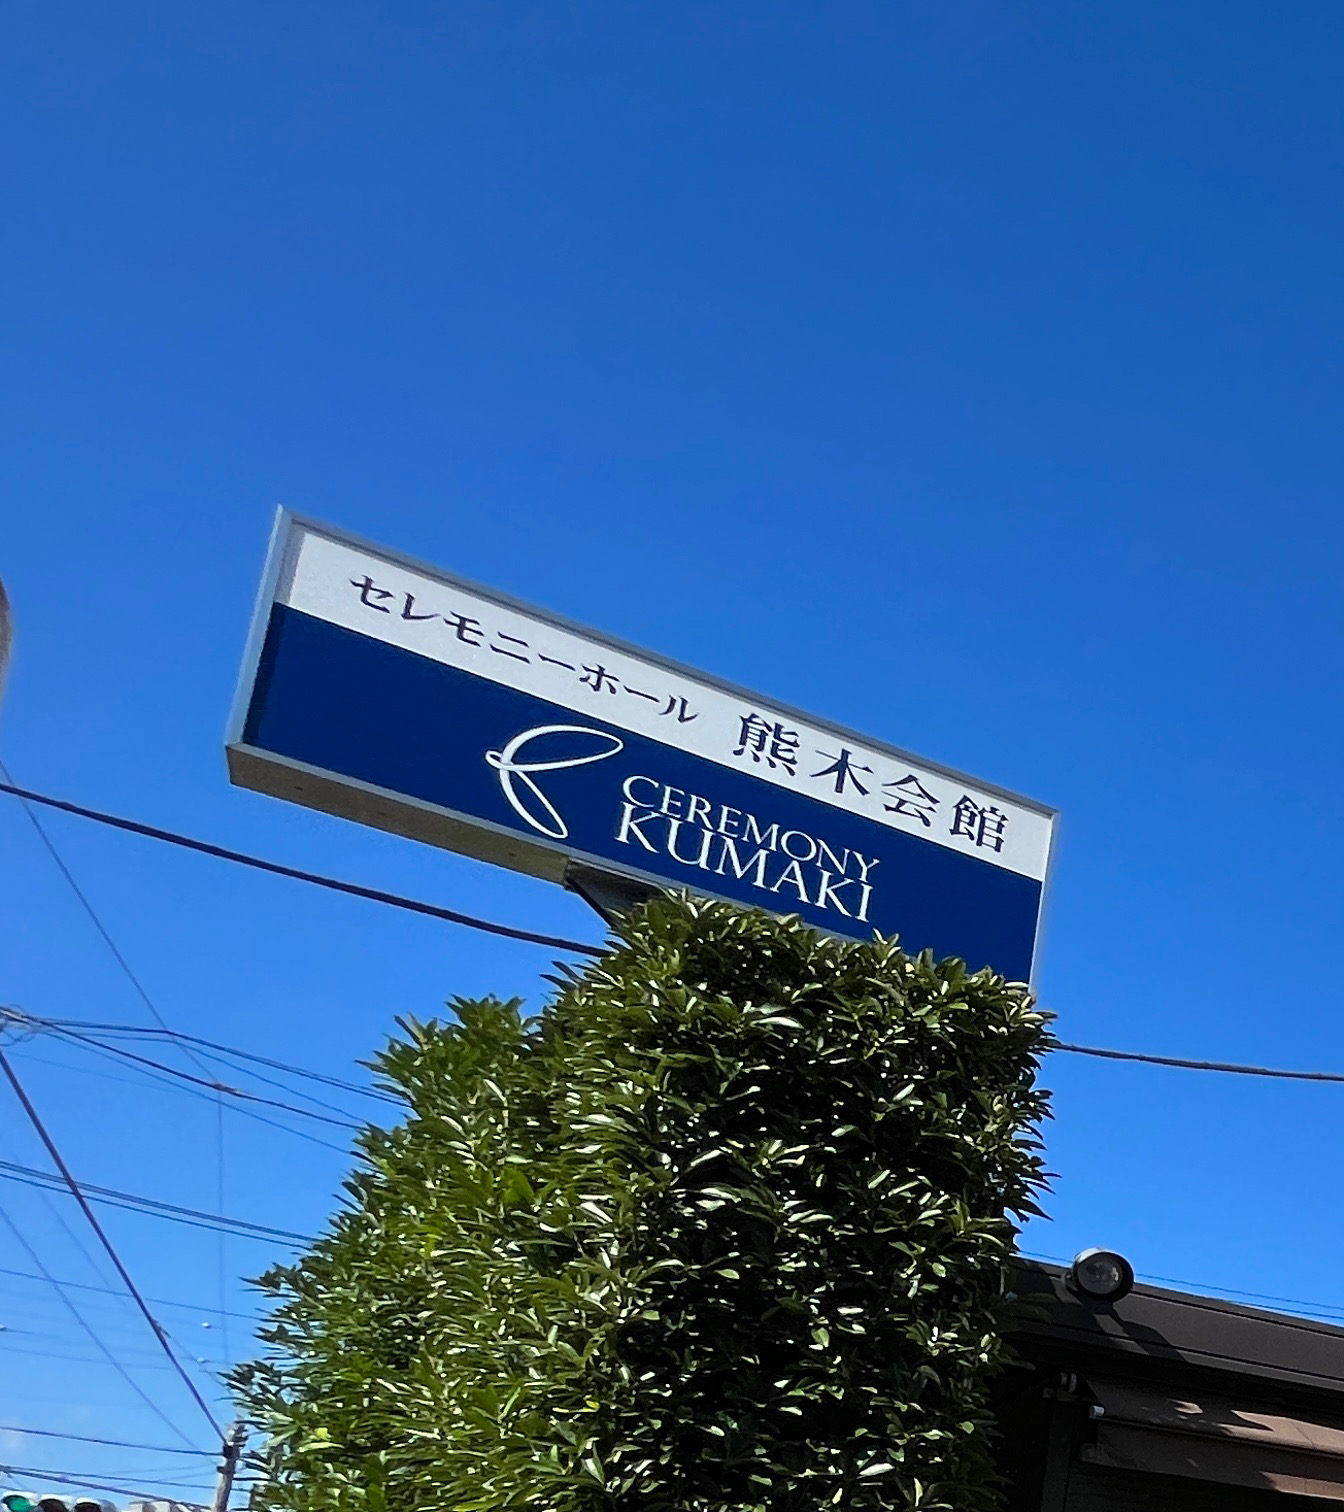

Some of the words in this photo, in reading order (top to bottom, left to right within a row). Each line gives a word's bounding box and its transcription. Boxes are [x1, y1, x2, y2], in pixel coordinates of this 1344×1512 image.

[349, 573, 700, 724] セレモニーホール
[732, 712, 1011, 854] 熊木会館
[613, 800, 875, 923] KUMAKI
[621, 774, 880, 883] CEREMONY
